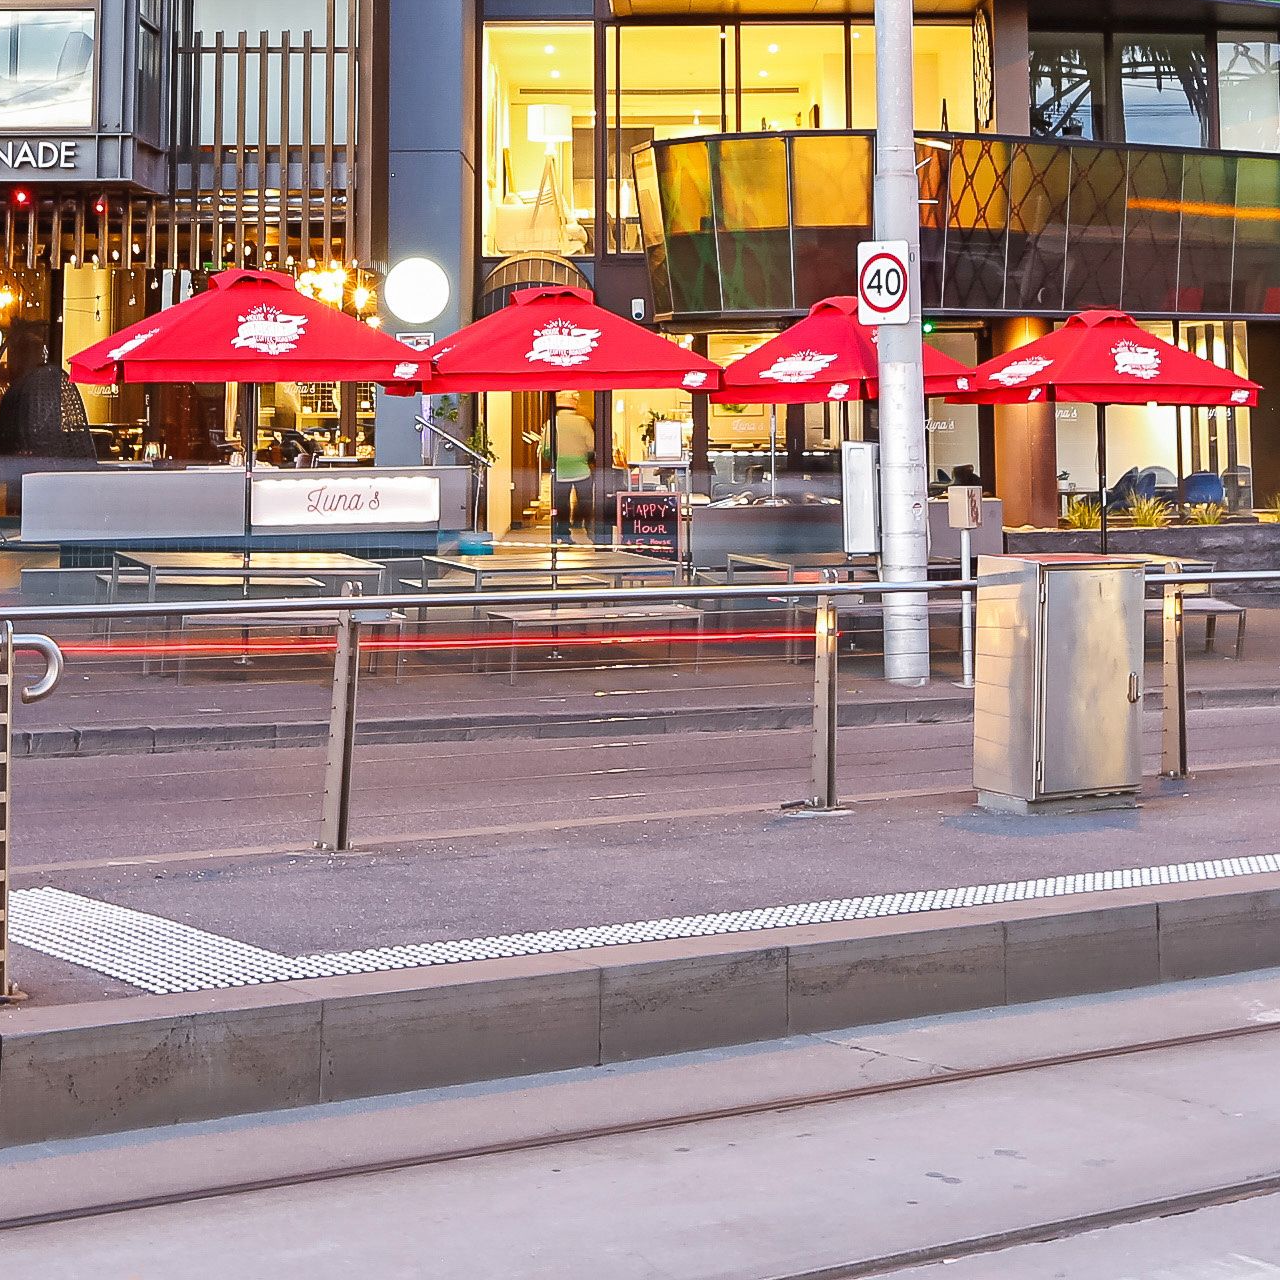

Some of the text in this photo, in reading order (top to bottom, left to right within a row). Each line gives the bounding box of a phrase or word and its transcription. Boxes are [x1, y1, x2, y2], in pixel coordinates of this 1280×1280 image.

[866, 268, 901, 296] 40
[307, 484, 380, 516] Luna's
[625, 501, 667, 519] HAPPY
[633, 519, 668, 534] HOUR
